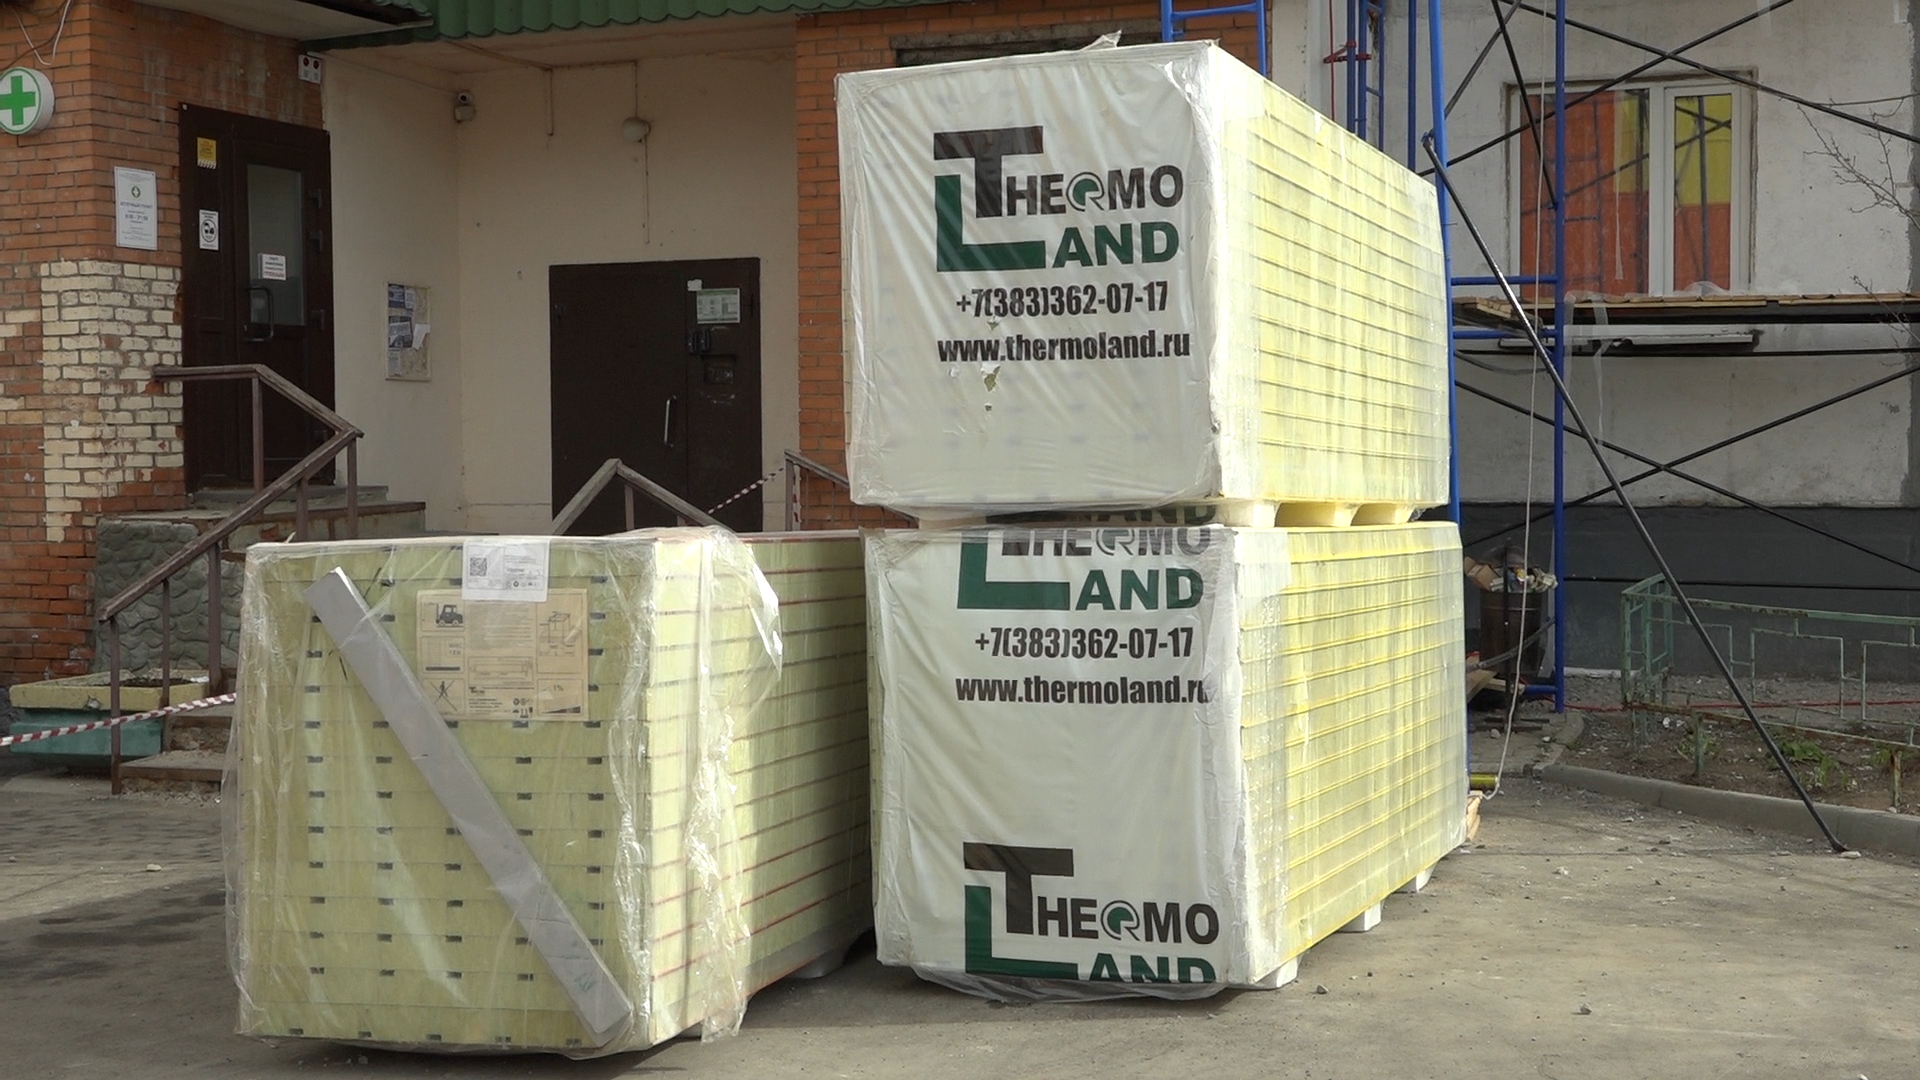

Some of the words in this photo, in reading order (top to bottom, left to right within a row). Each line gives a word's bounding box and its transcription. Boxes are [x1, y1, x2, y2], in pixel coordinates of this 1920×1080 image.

[934, 174, 1180, 272] LAND
[956, 281, 1169, 318] +7(383)362-07-17
[937, 330, 1191, 362] www.thermoland.ru
[1001, 528, 1211, 556] HERMO
[957, 529, 1204, 611] LAND
[975, 627, 1194, 659] +7(383)362-07-17
